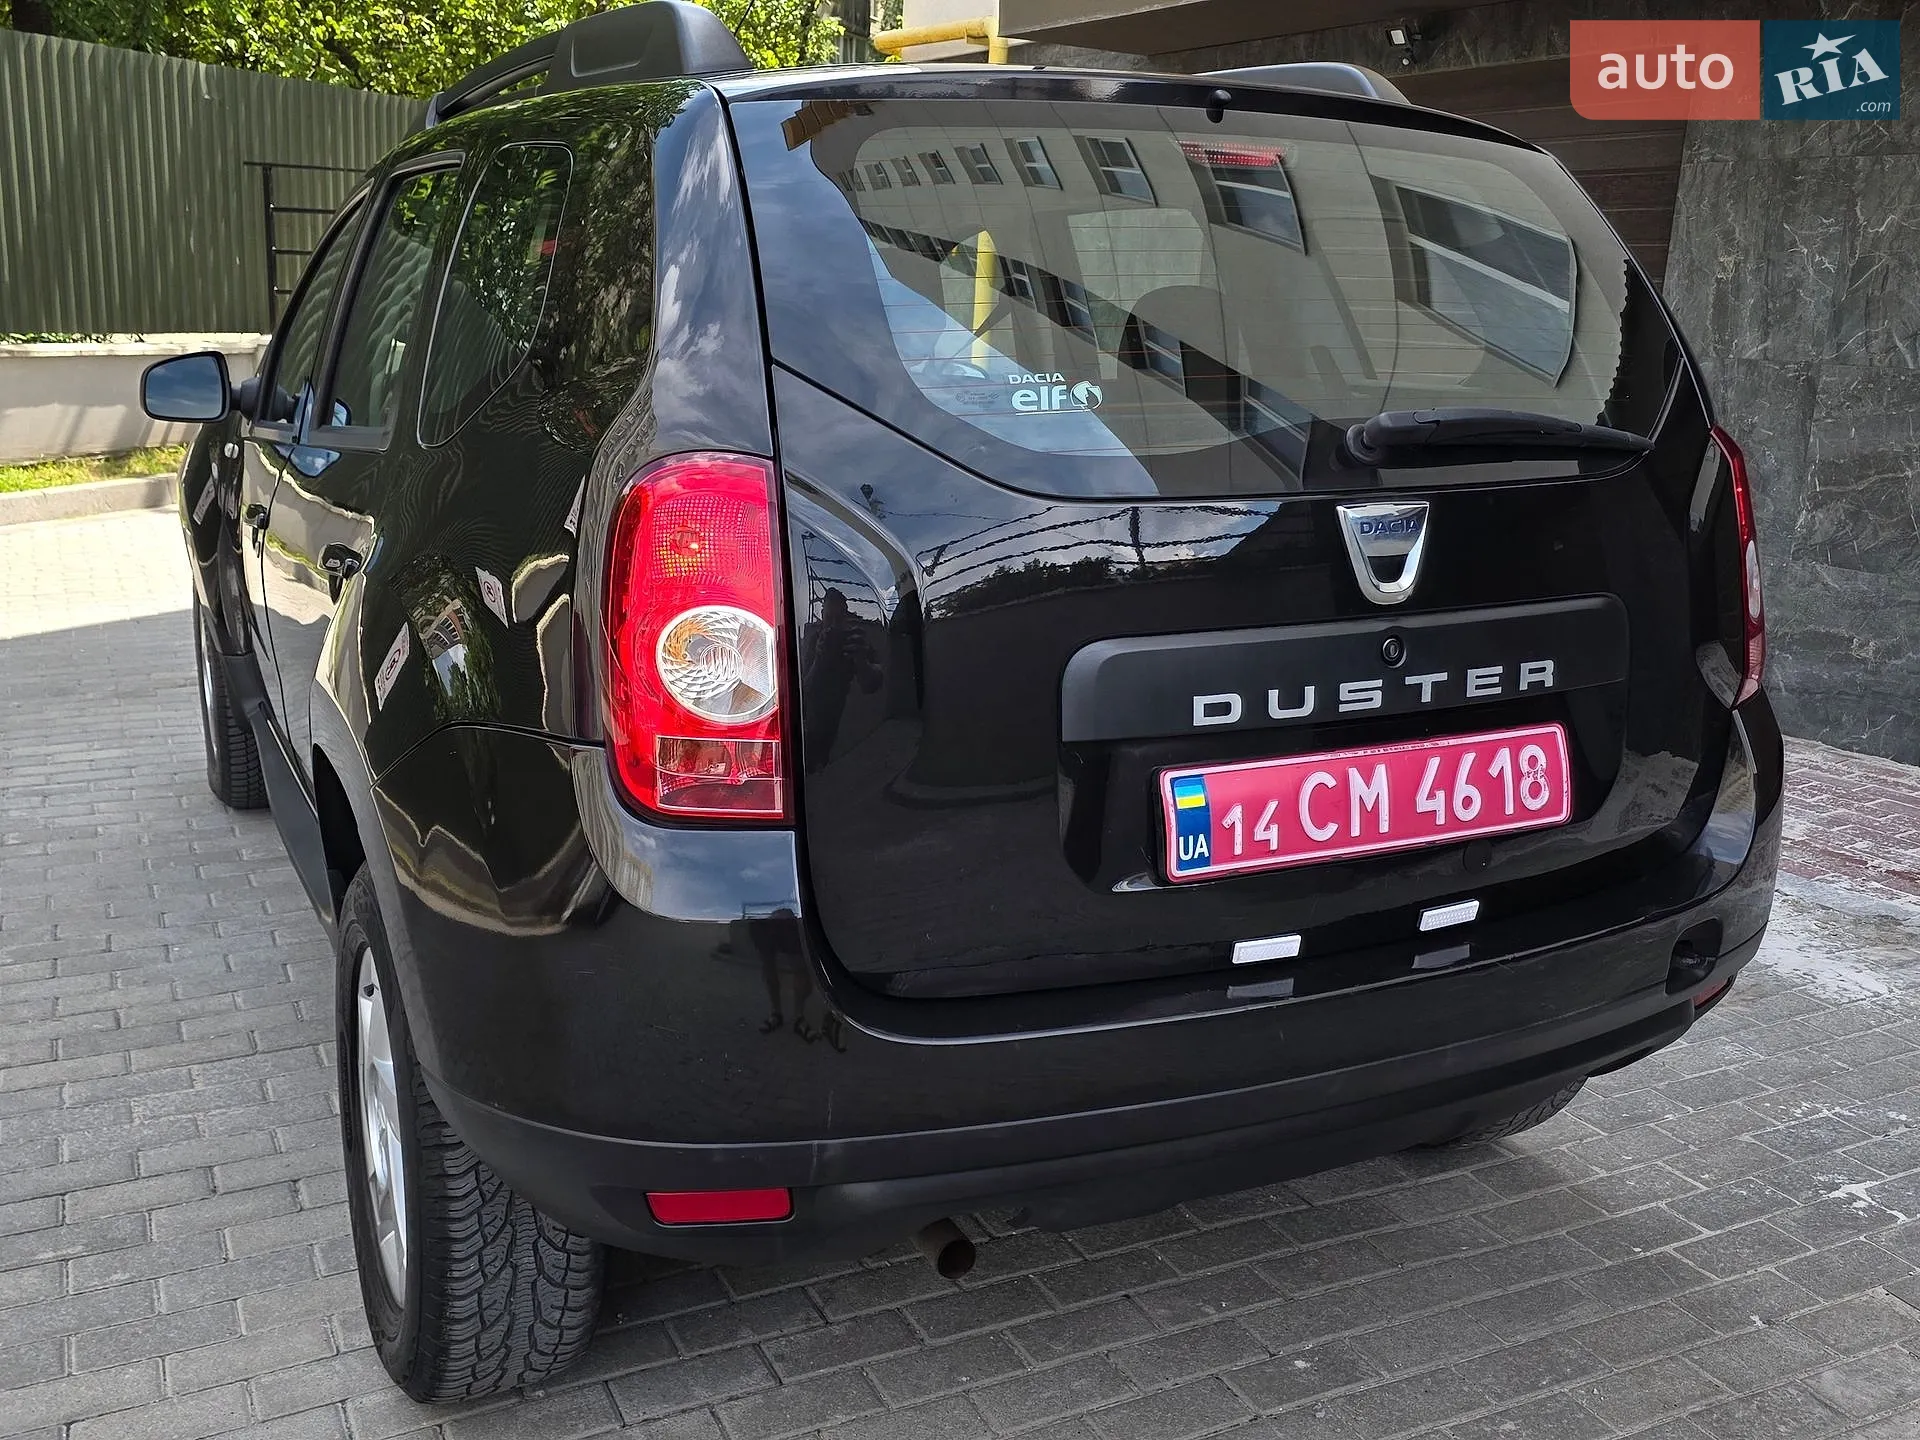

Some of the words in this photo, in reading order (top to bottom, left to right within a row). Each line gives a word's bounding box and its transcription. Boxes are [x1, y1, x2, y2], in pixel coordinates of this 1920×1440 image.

[1007, 372, 1065, 385] DACIA
[1011, 385, 1067, 411] elf
[1360, 519, 1420, 536] DACIA
[1192, 659, 1555, 727] DUSTER
[1221, 800, 1279, 856] 14
[1299, 763, 1390, 842] CM
[1415, 744, 1551, 826] 4618
[1178, 833, 1210, 862] UA
